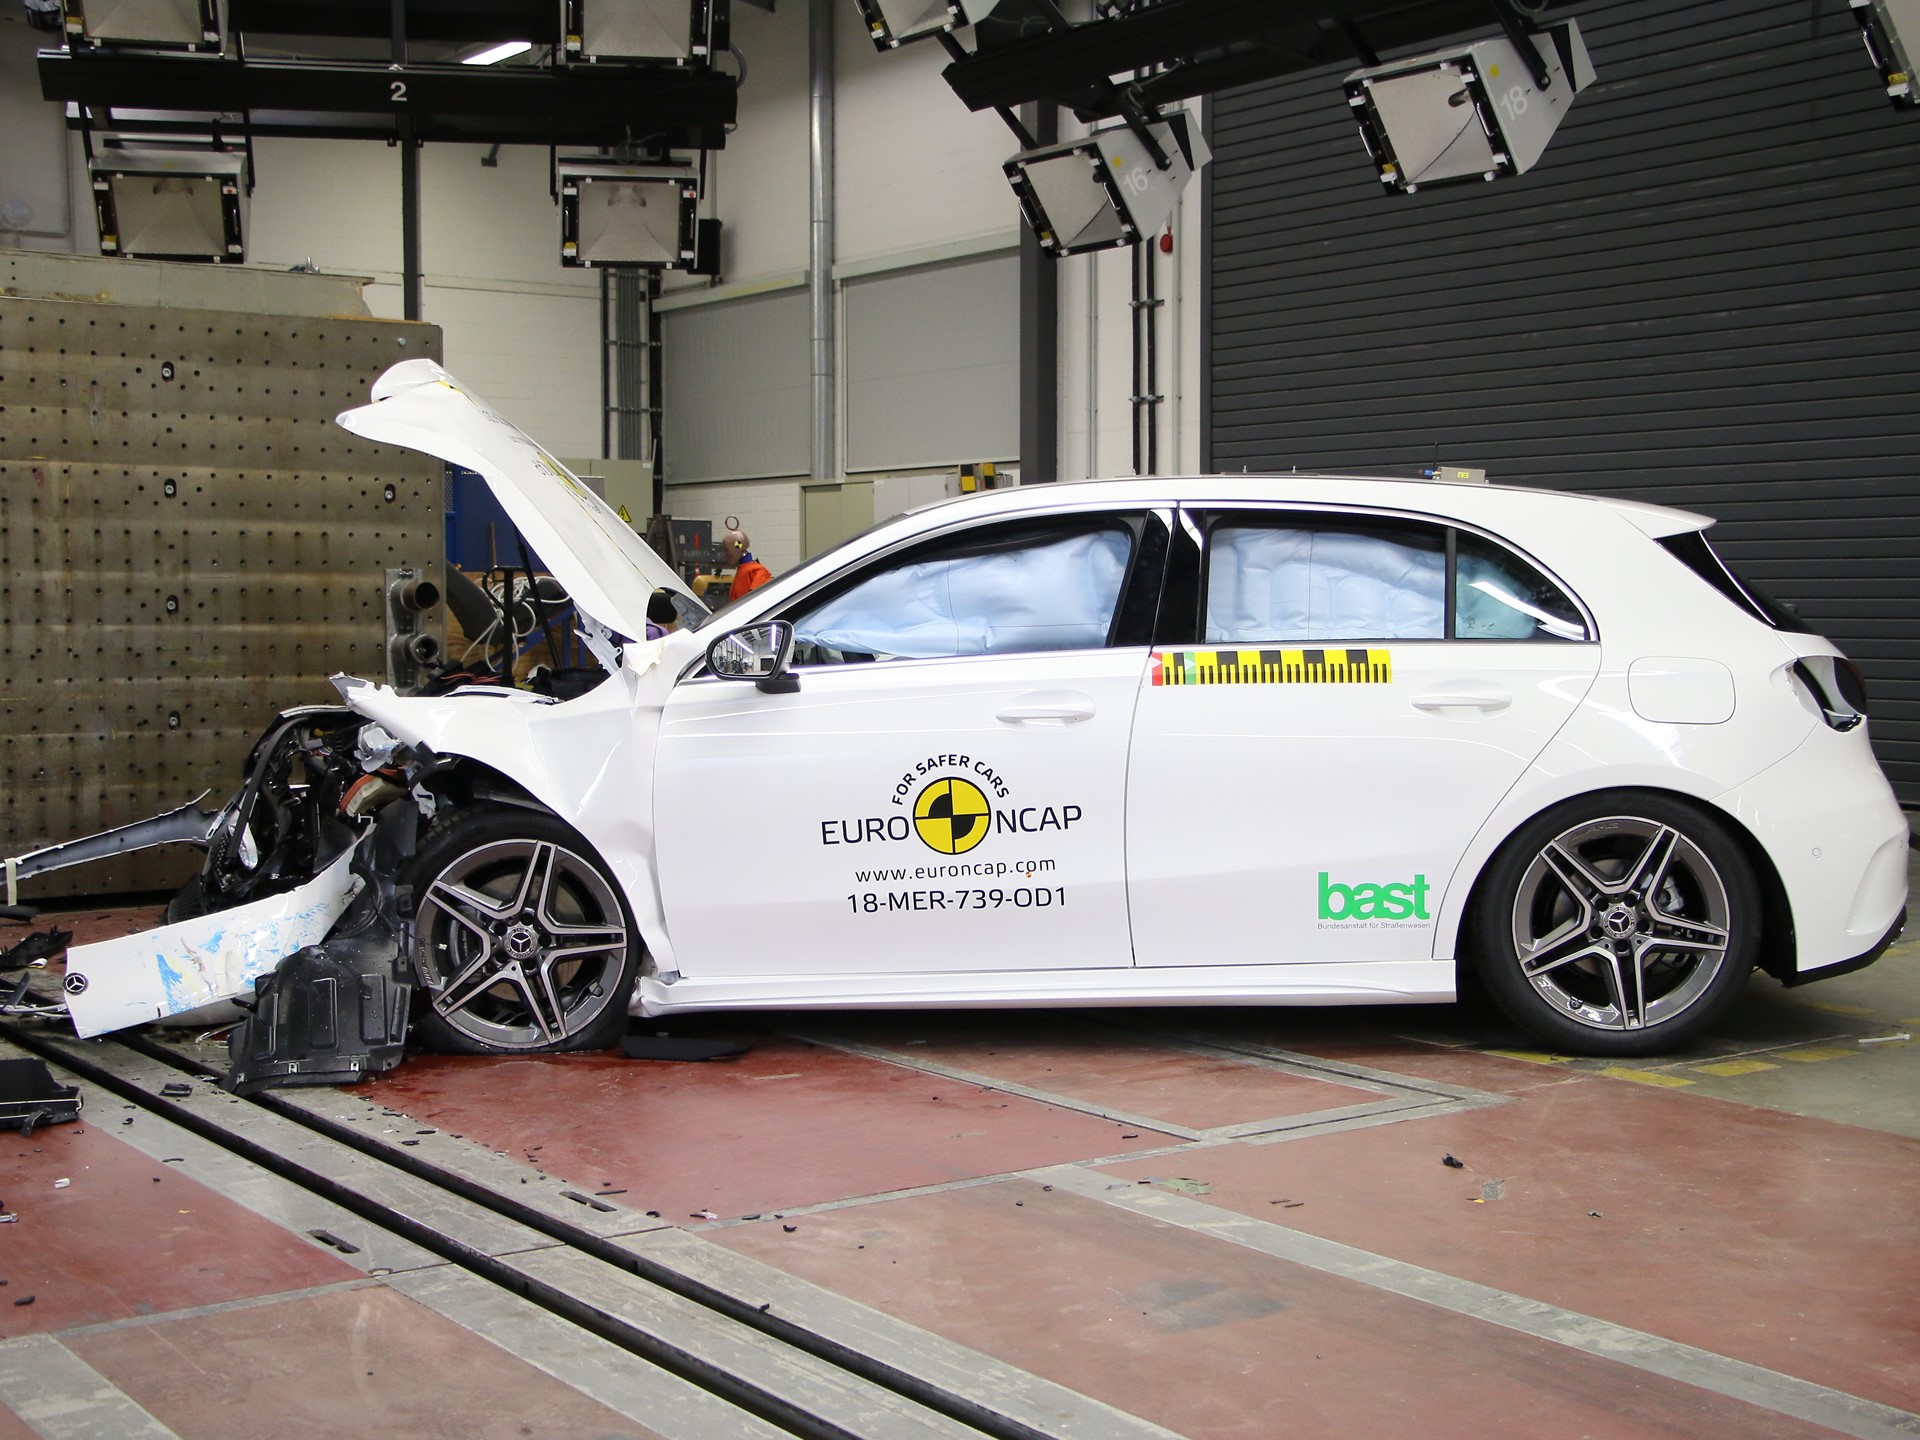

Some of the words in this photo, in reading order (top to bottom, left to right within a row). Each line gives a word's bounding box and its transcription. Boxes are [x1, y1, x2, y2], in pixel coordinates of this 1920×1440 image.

[390, 81, 408, 101] 2
[1501, 86, 1528, 121] 18
[1123, 167, 1148, 197] 16
[891, 772, 917, 805] FOR
[916, 754, 970, 775] SAFER
[974, 761, 1010, 798] CARS
[821, 816, 910, 845] EURO
[996, 805, 1082, 834] NCAP
[855, 859, 1056, 882] www.euroncap.com
[847, 887, 1066, 913] 18-MER-739-OD1
[1318, 872, 1430, 920] bast
